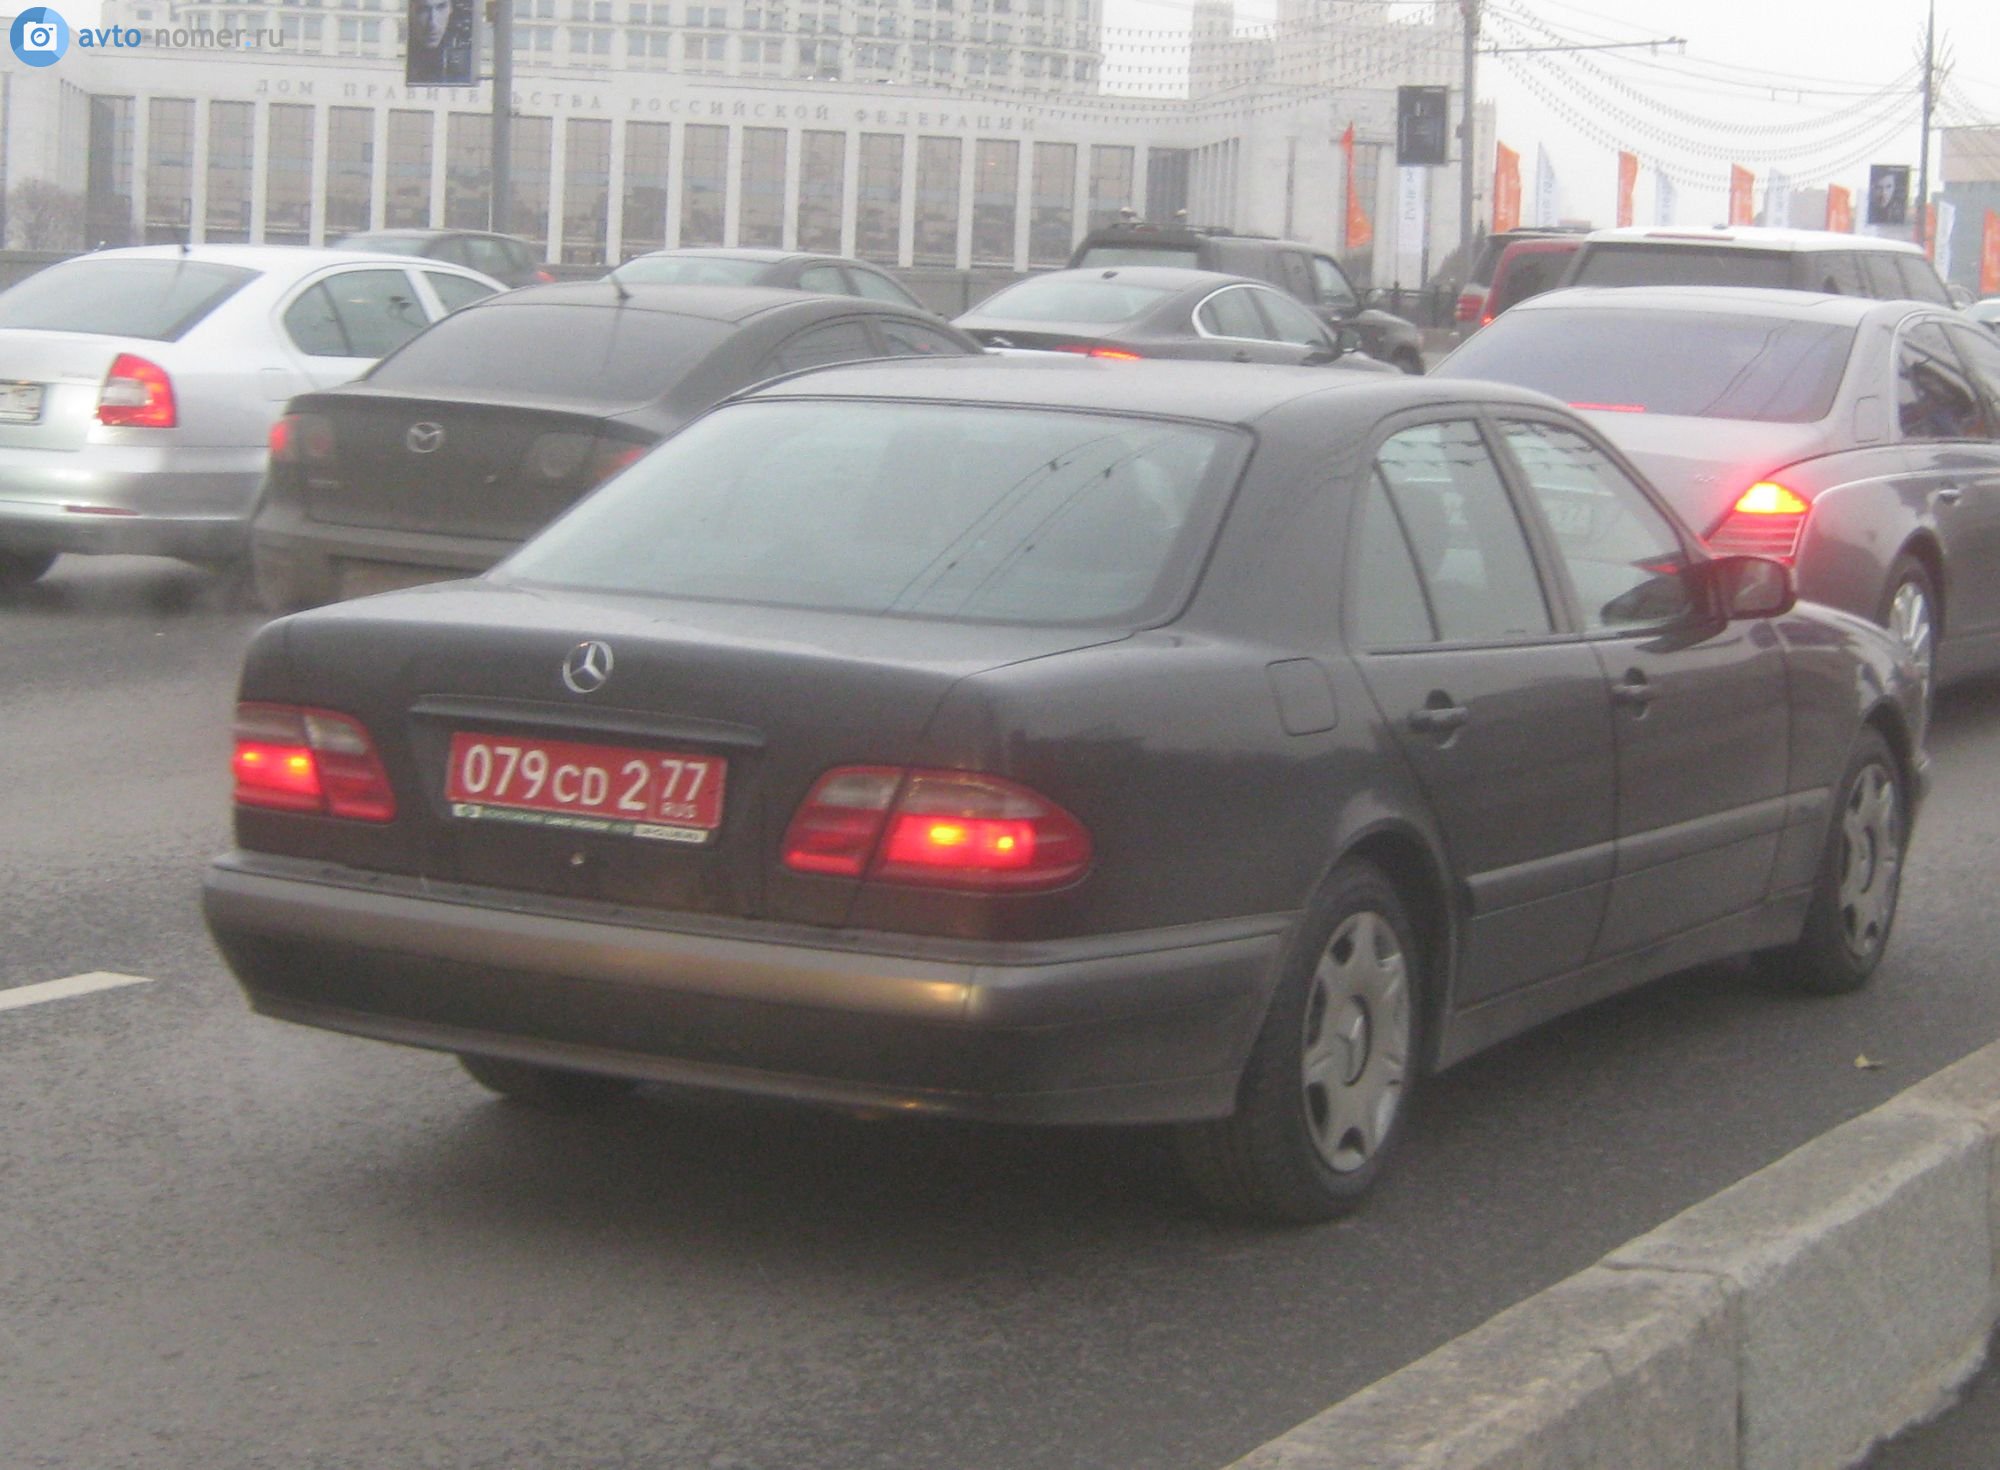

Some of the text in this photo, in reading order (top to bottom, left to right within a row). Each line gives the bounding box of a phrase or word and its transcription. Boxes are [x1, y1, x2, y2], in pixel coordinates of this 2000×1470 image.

[254, 78, 1036, 132] ДОМ ПРАВИТЕЬСТВА РОССИЙСКОЙ ФЕДЕРАЦИИ
[661, 801, 699, 819] RUS
